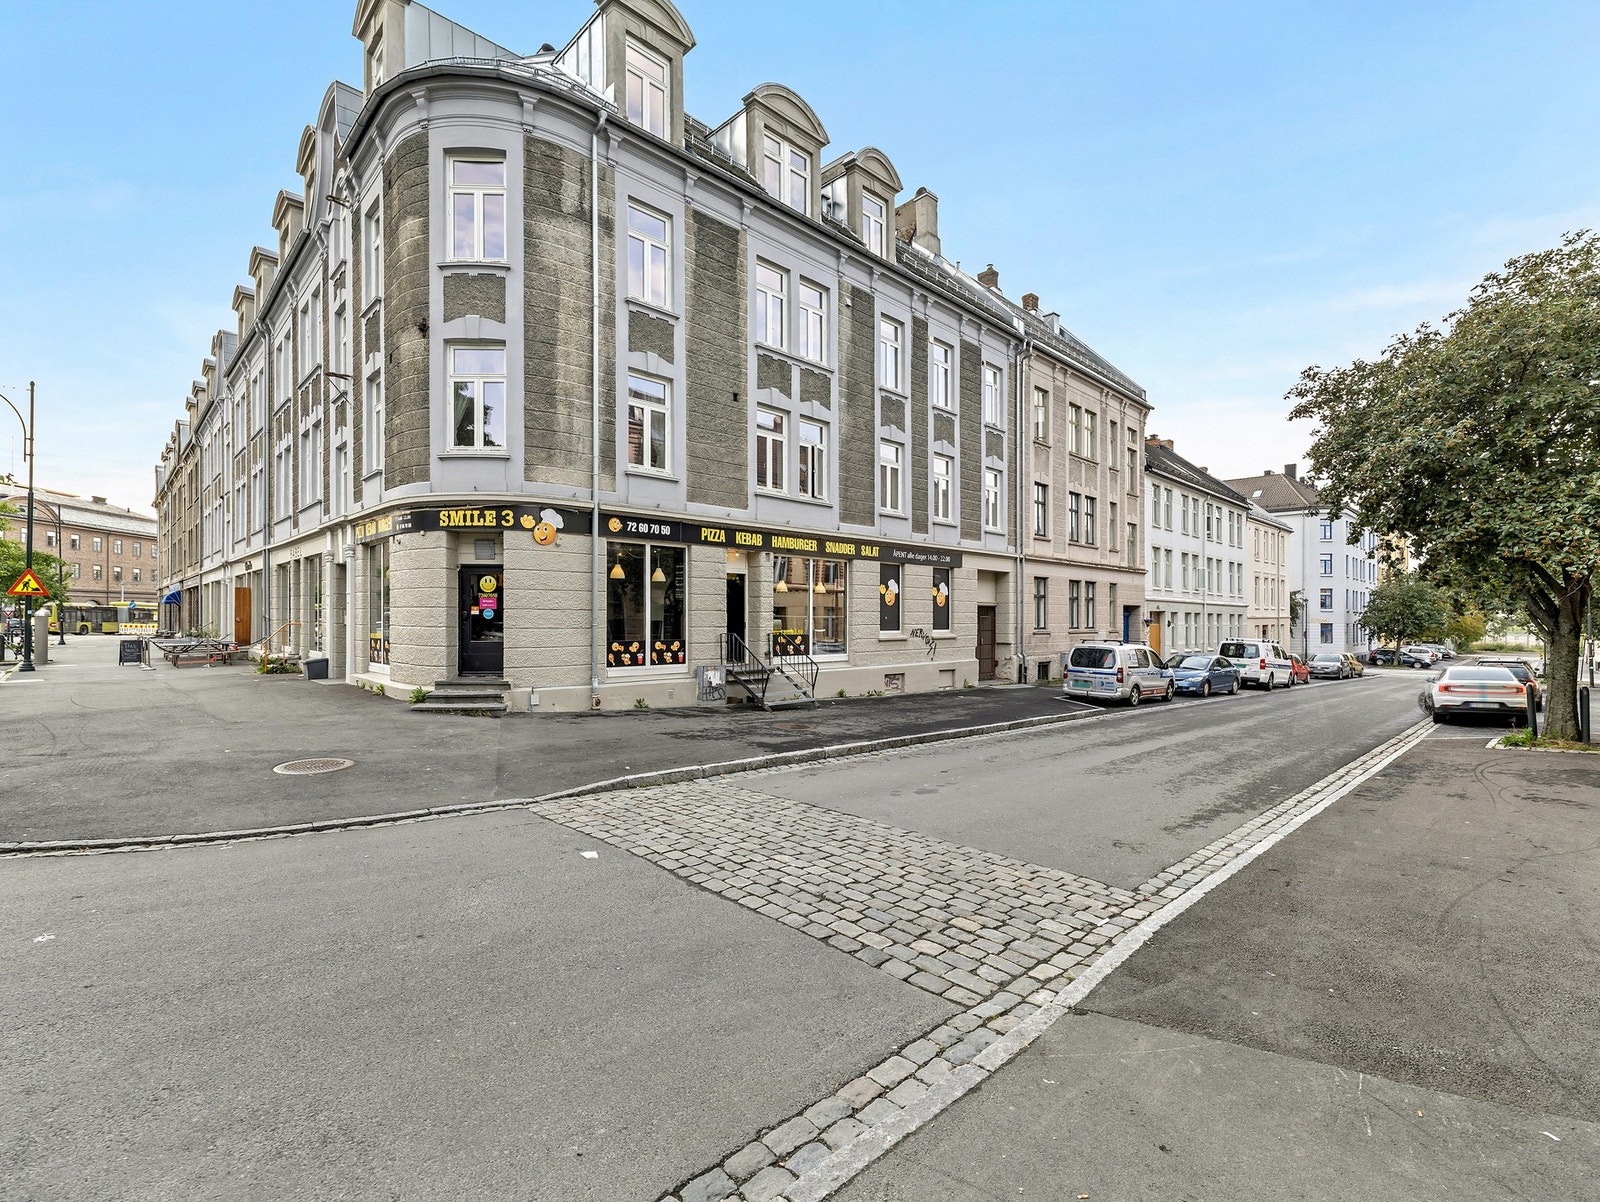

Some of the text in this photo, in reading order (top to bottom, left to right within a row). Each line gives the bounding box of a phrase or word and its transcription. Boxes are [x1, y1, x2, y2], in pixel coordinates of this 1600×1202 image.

[440, 509, 515, 527] SMILE 3
[626, 521, 671, 535] 72 60 70 50
[701, 527, 880, 557] PIZZA KEBAB HAMBURGER SNADDER SALAT
[893, 549, 907, 559] ÅPENT
[907, 552, 915, 560] alle
[915, 553, 927, 562] dager
